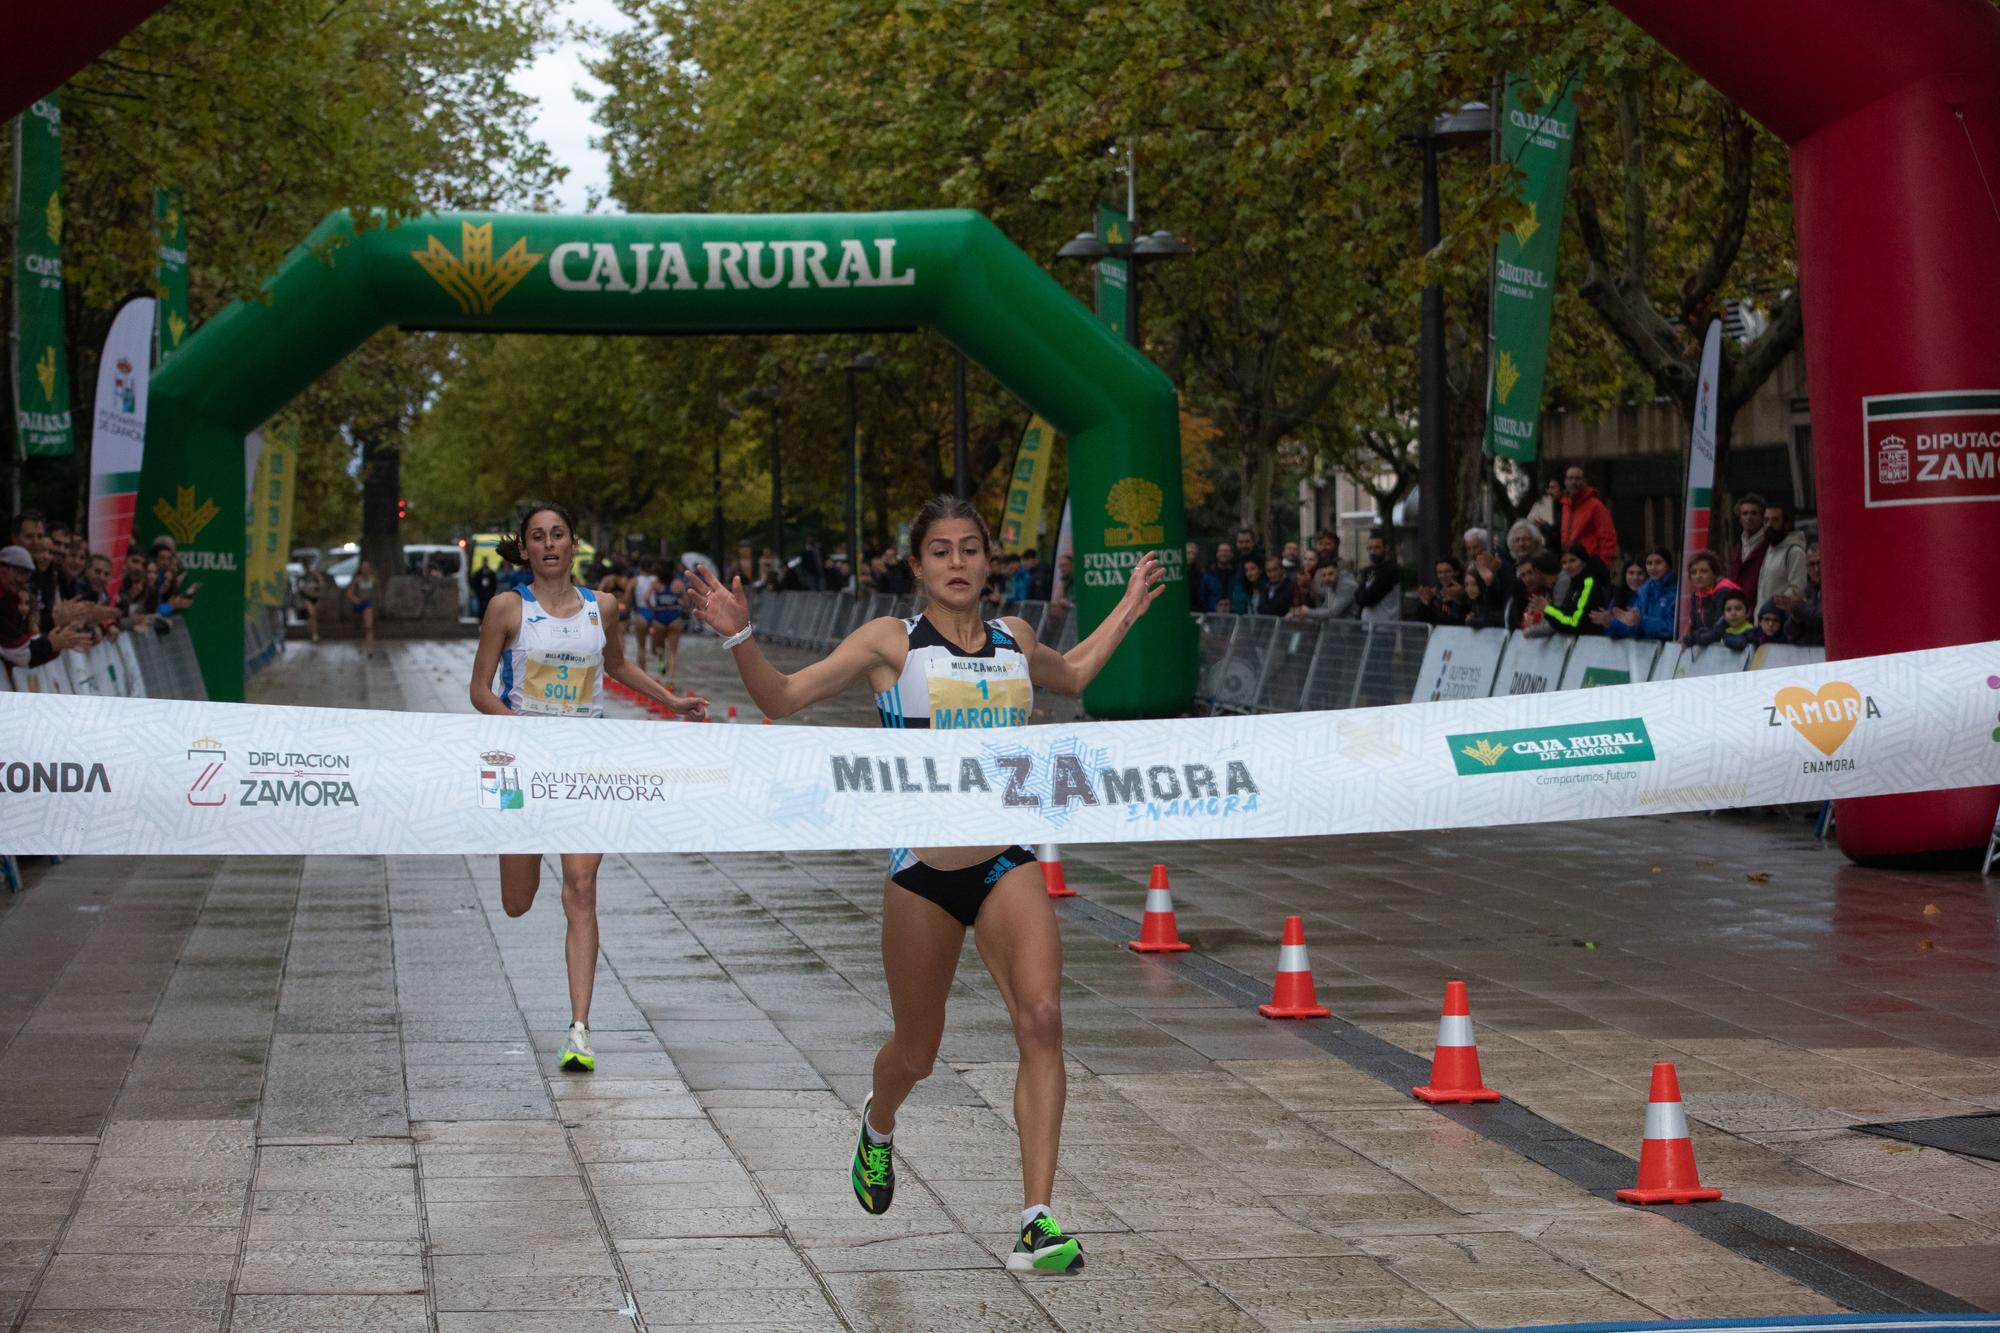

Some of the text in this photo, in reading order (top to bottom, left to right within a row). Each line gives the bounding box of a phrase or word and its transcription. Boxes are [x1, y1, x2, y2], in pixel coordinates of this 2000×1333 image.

[549, 239, 915, 294] CAJA RURAL
[1916, 452, 2000, 481] ZAM
[1084, 569, 1125, 586] CAJA
[556, 665, 569, 680] 3
[544, 683, 577, 701] SOLI
[976, 679, 989, 700] 1
[935, 707, 1026, 729] MARQUES
[1763, 696, 1881, 727] ZAMORA
[1512, 732, 1643, 754] CAJA RURAL
[1540, 745, 1624, 761] DE ZAMORA
[1802, 759, 1856, 774] ENAMORA
[531, 771, 664, 786] AYUNTAMIENTO
[1536, 770, 1637, 786] Compartimos futuro
[239, 780, 360, 807] ZAMORA
[531, 784, 666, 801] DE ZAMORA
